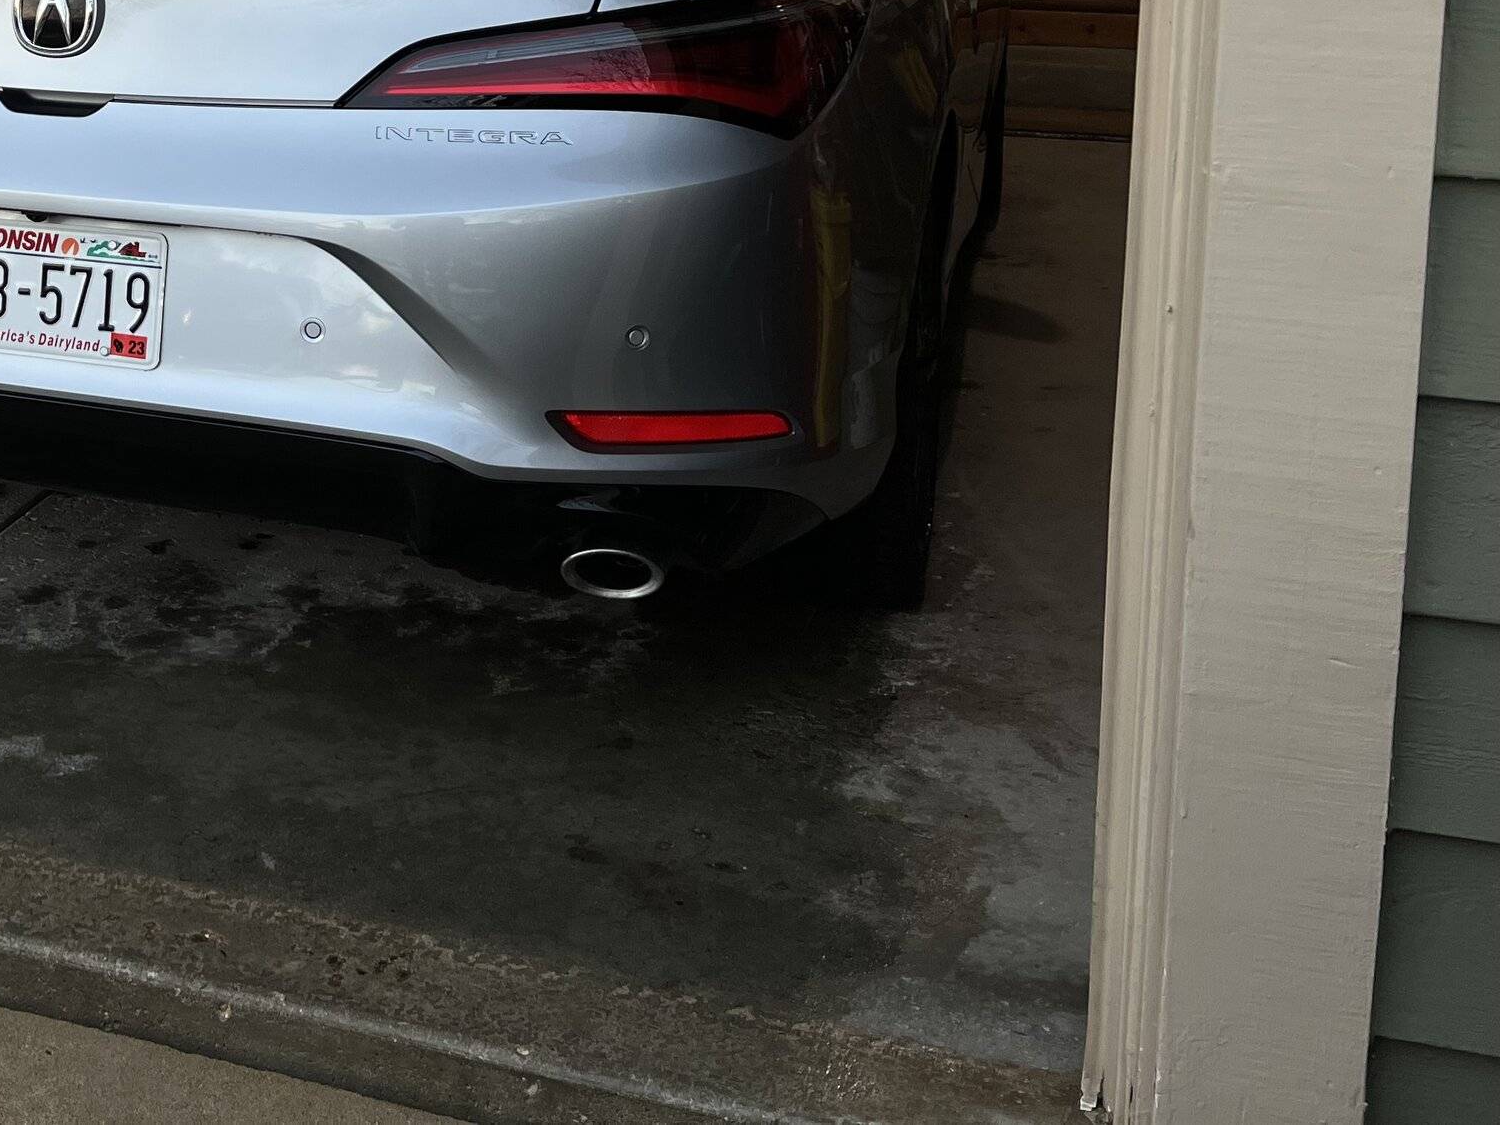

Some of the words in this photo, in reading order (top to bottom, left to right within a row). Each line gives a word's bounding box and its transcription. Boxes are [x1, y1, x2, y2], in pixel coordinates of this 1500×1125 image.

[375, 125, 574, 146] INTEGRA
[38, 332, 100, 352] Dairyland
[128, 339, 145, 356] 23
